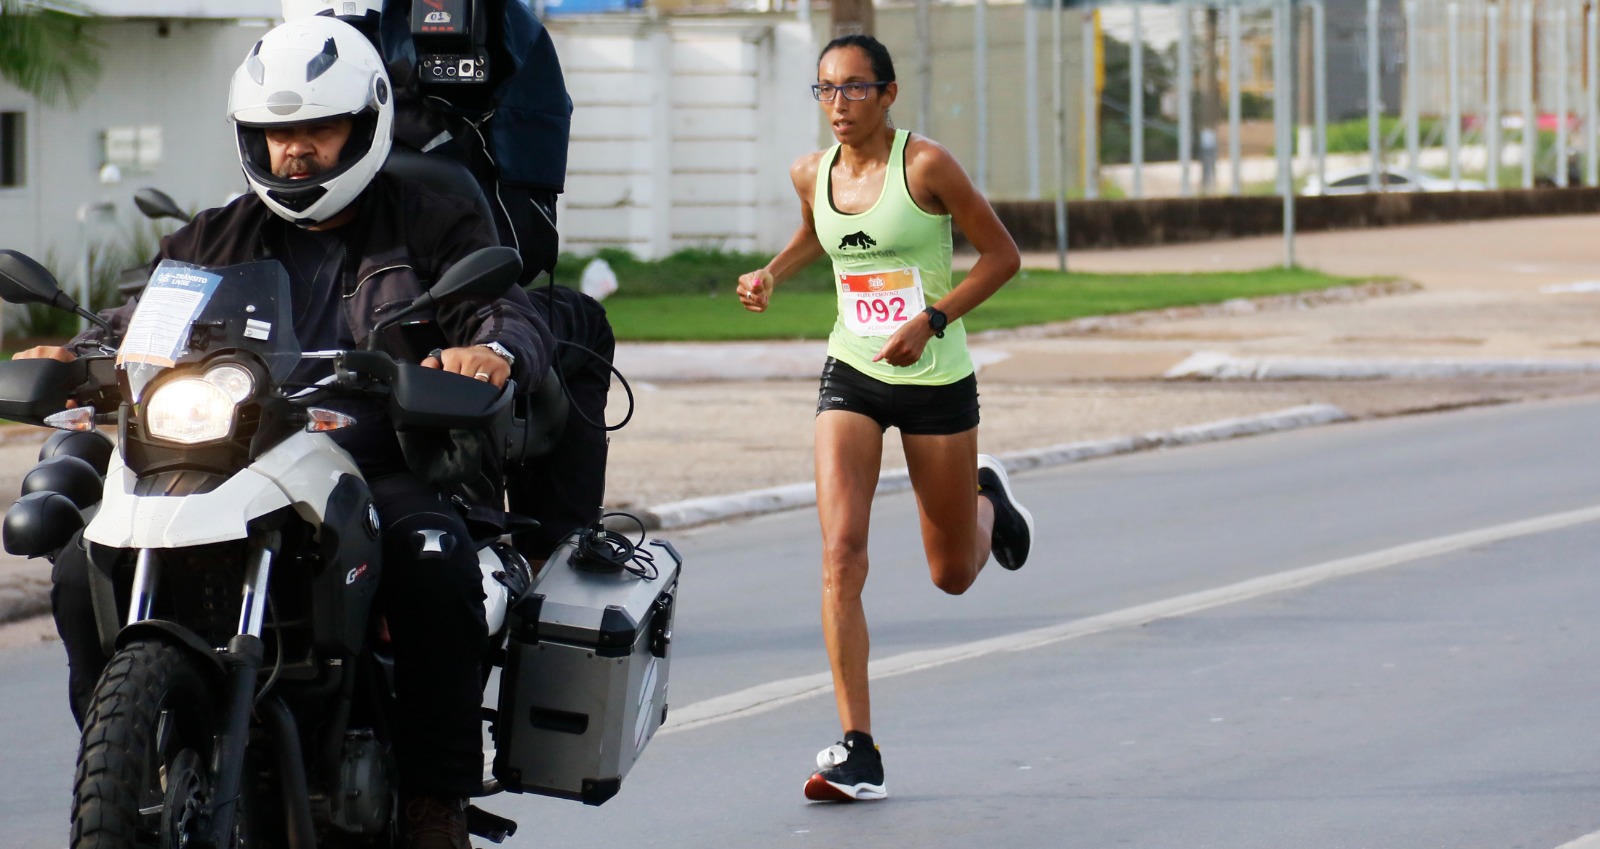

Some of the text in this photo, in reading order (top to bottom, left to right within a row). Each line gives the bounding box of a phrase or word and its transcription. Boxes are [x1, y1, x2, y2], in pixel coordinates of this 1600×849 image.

[171, 278, 191, 287] LIVRE
[175, 273, 208, 284] TRÂNSITO
[856, 296, 908, 324] 092
